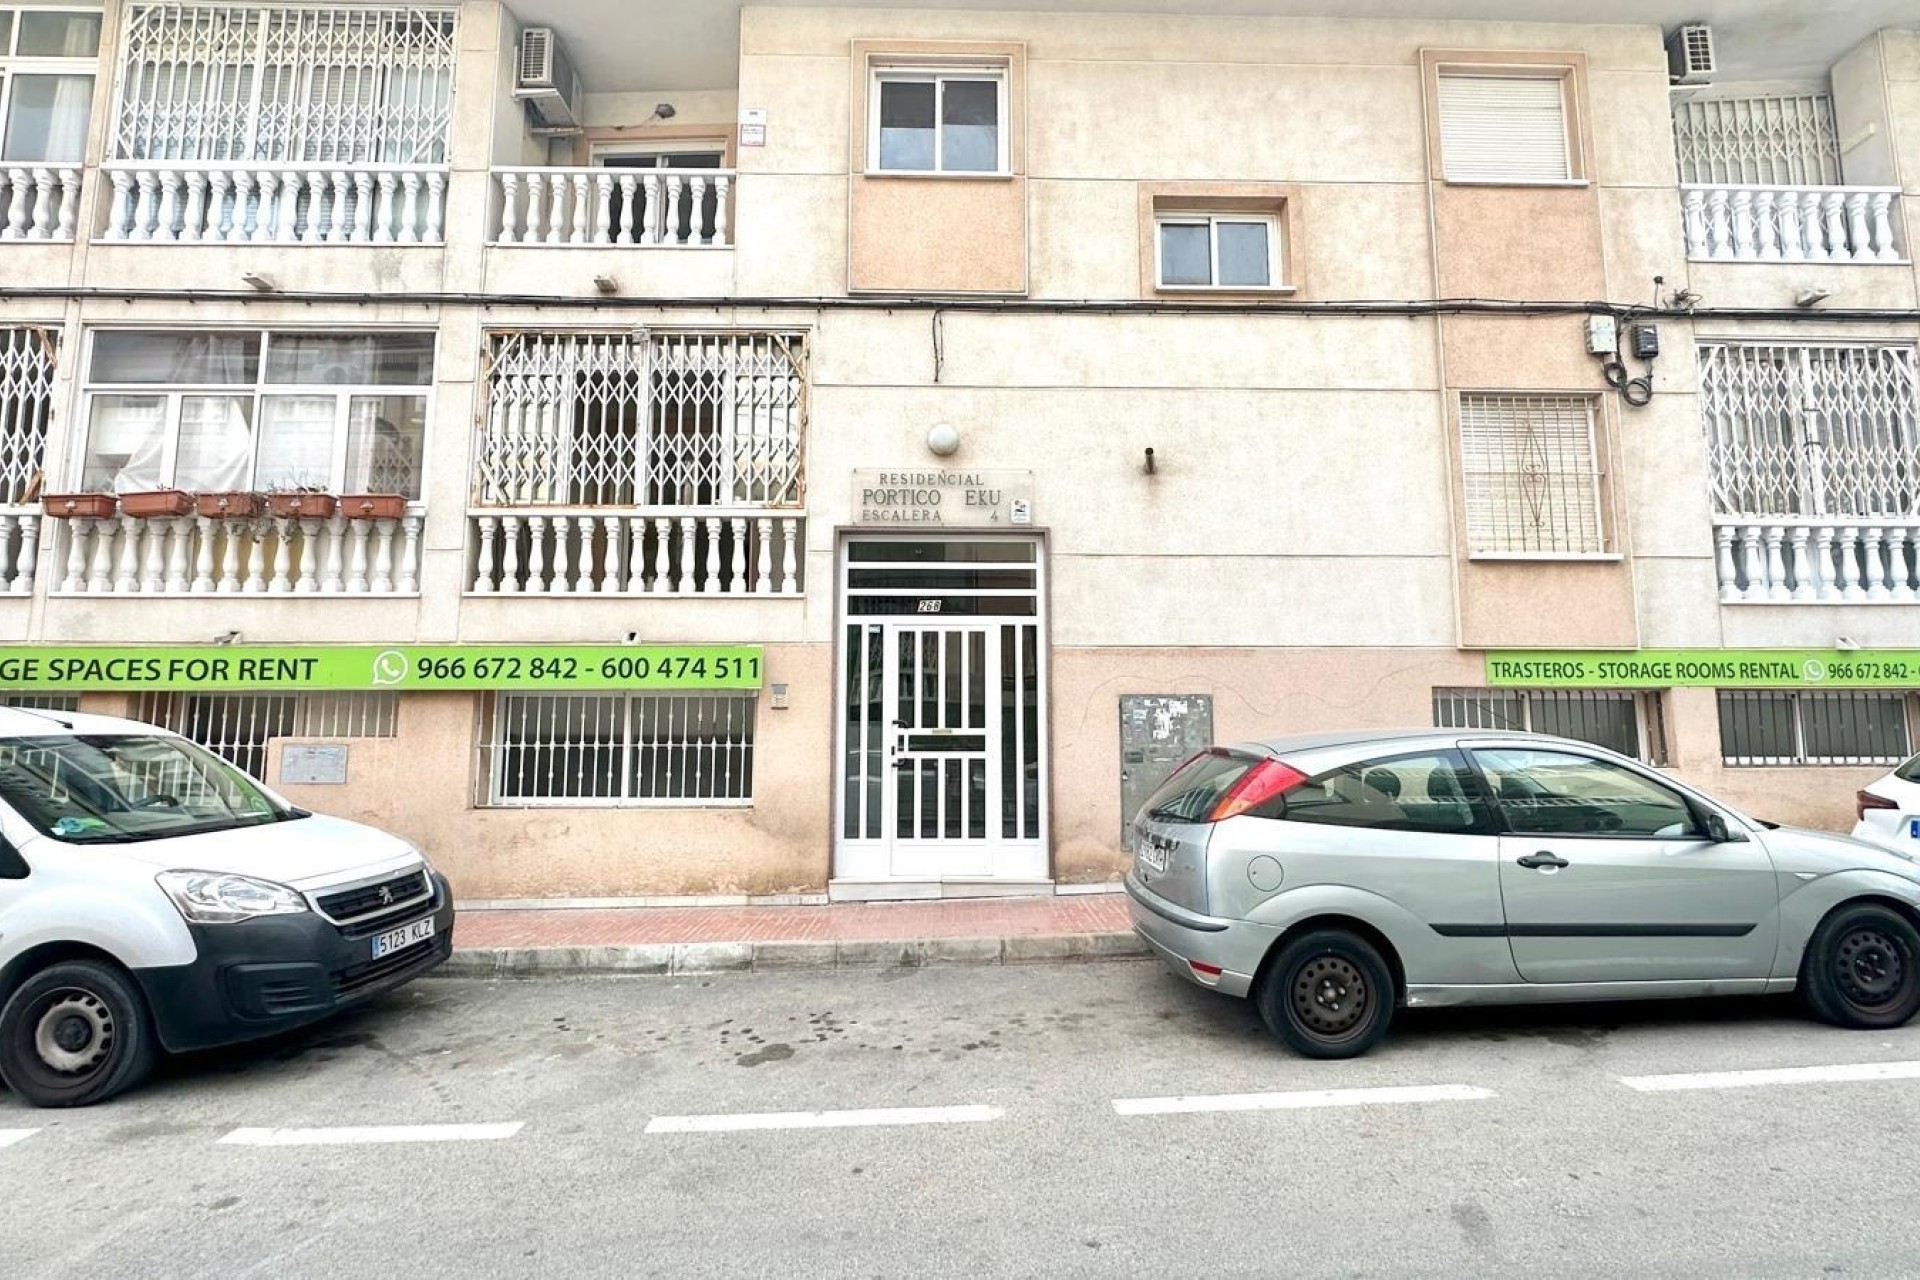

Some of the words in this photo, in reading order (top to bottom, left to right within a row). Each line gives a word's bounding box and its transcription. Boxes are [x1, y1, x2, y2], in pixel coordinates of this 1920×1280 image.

[879, 472, 984, 486] RESIDENCIAL
[862, 488, 941, 506] PORTICO
[965, 489, 1001, 506] EKU
[862, 509, 942, 521] ESCALERA
[990, 510, 999, 521] 4
[47, 658, 161, 681] SPACES
[168, 658, 229, 681] FOR
[238, 658, 319, 681] RENT
[417, 657, 466, 679] 966
[473, 657, 521, 679] 672
[529, 657, 578, 679] 842
[601, 657, 650, 679] 600
[656, 657, 707, 679] 474
[714, 657, 759, 679] 511
[1490, 662, 1585, 679] TRASTEROS
[1597, 662, 1673, 679] STORAGE
[1676, 662, 1736, 679] ROOMS
[1739, 662, 1800, 679] RENTAL
[1828, 663, 1854, 679] 966
[1855, 663, 1881, 679] 672
[1883, 663, 1908, 679] 842
[380, 929, 406, 953] 5123
[411, 920, 430, 940] KLZ
